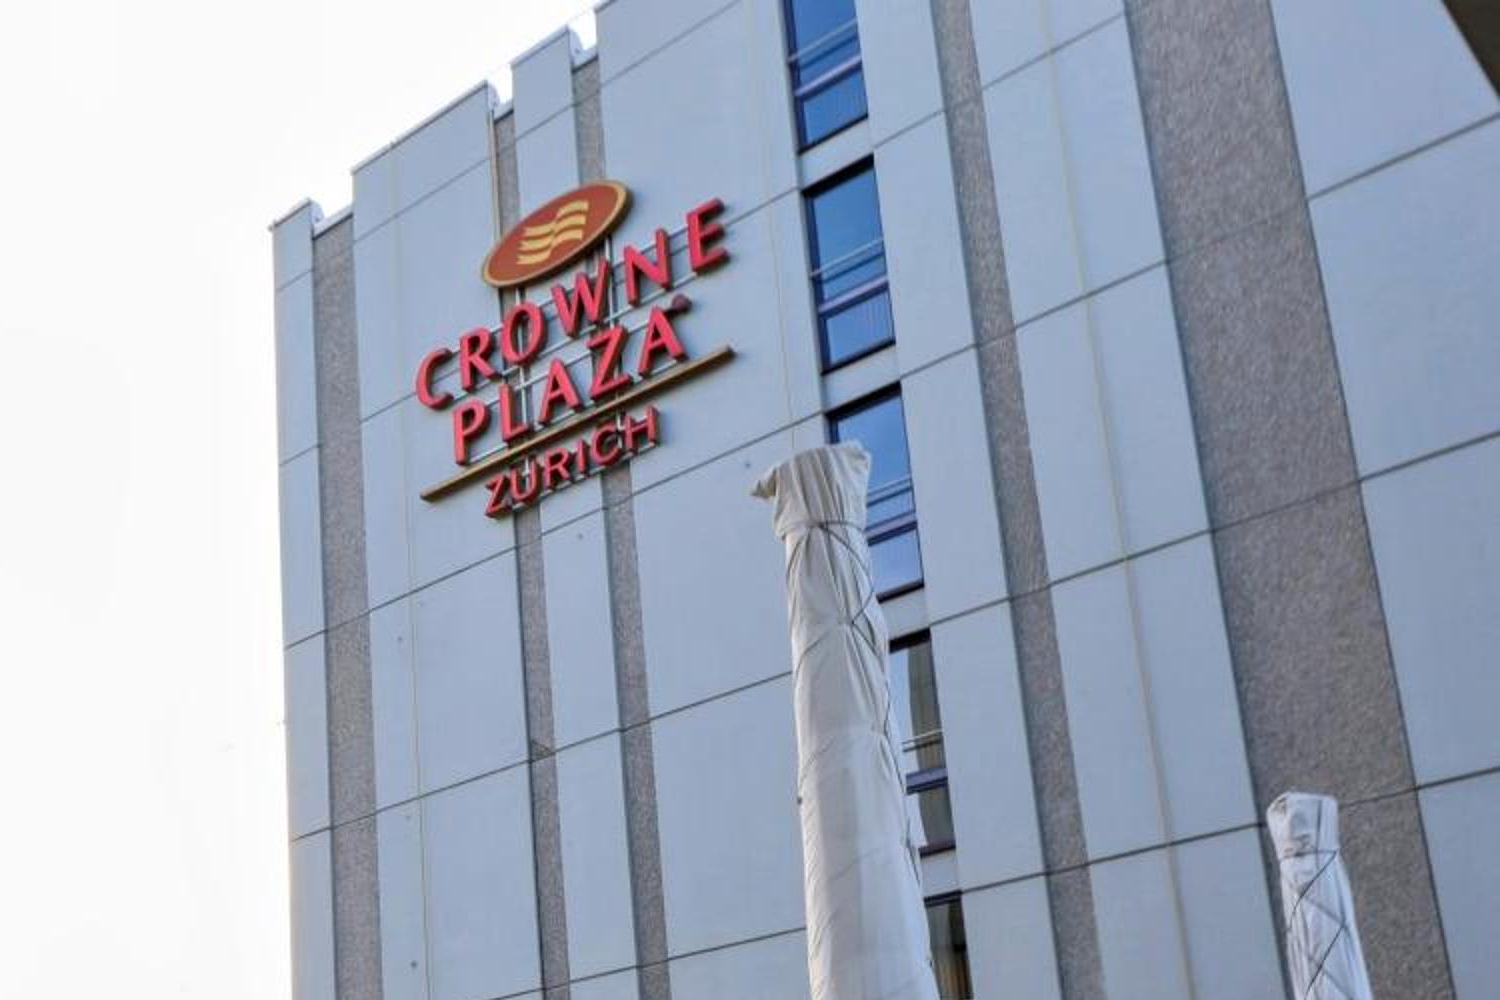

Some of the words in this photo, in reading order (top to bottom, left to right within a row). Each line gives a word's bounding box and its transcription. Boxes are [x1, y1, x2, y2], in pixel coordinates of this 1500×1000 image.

[415, 197, 731, 410] CROWNE
[451, 304, 688, 467] PLAZA
[484, 405, 661, 519] ZURICH
